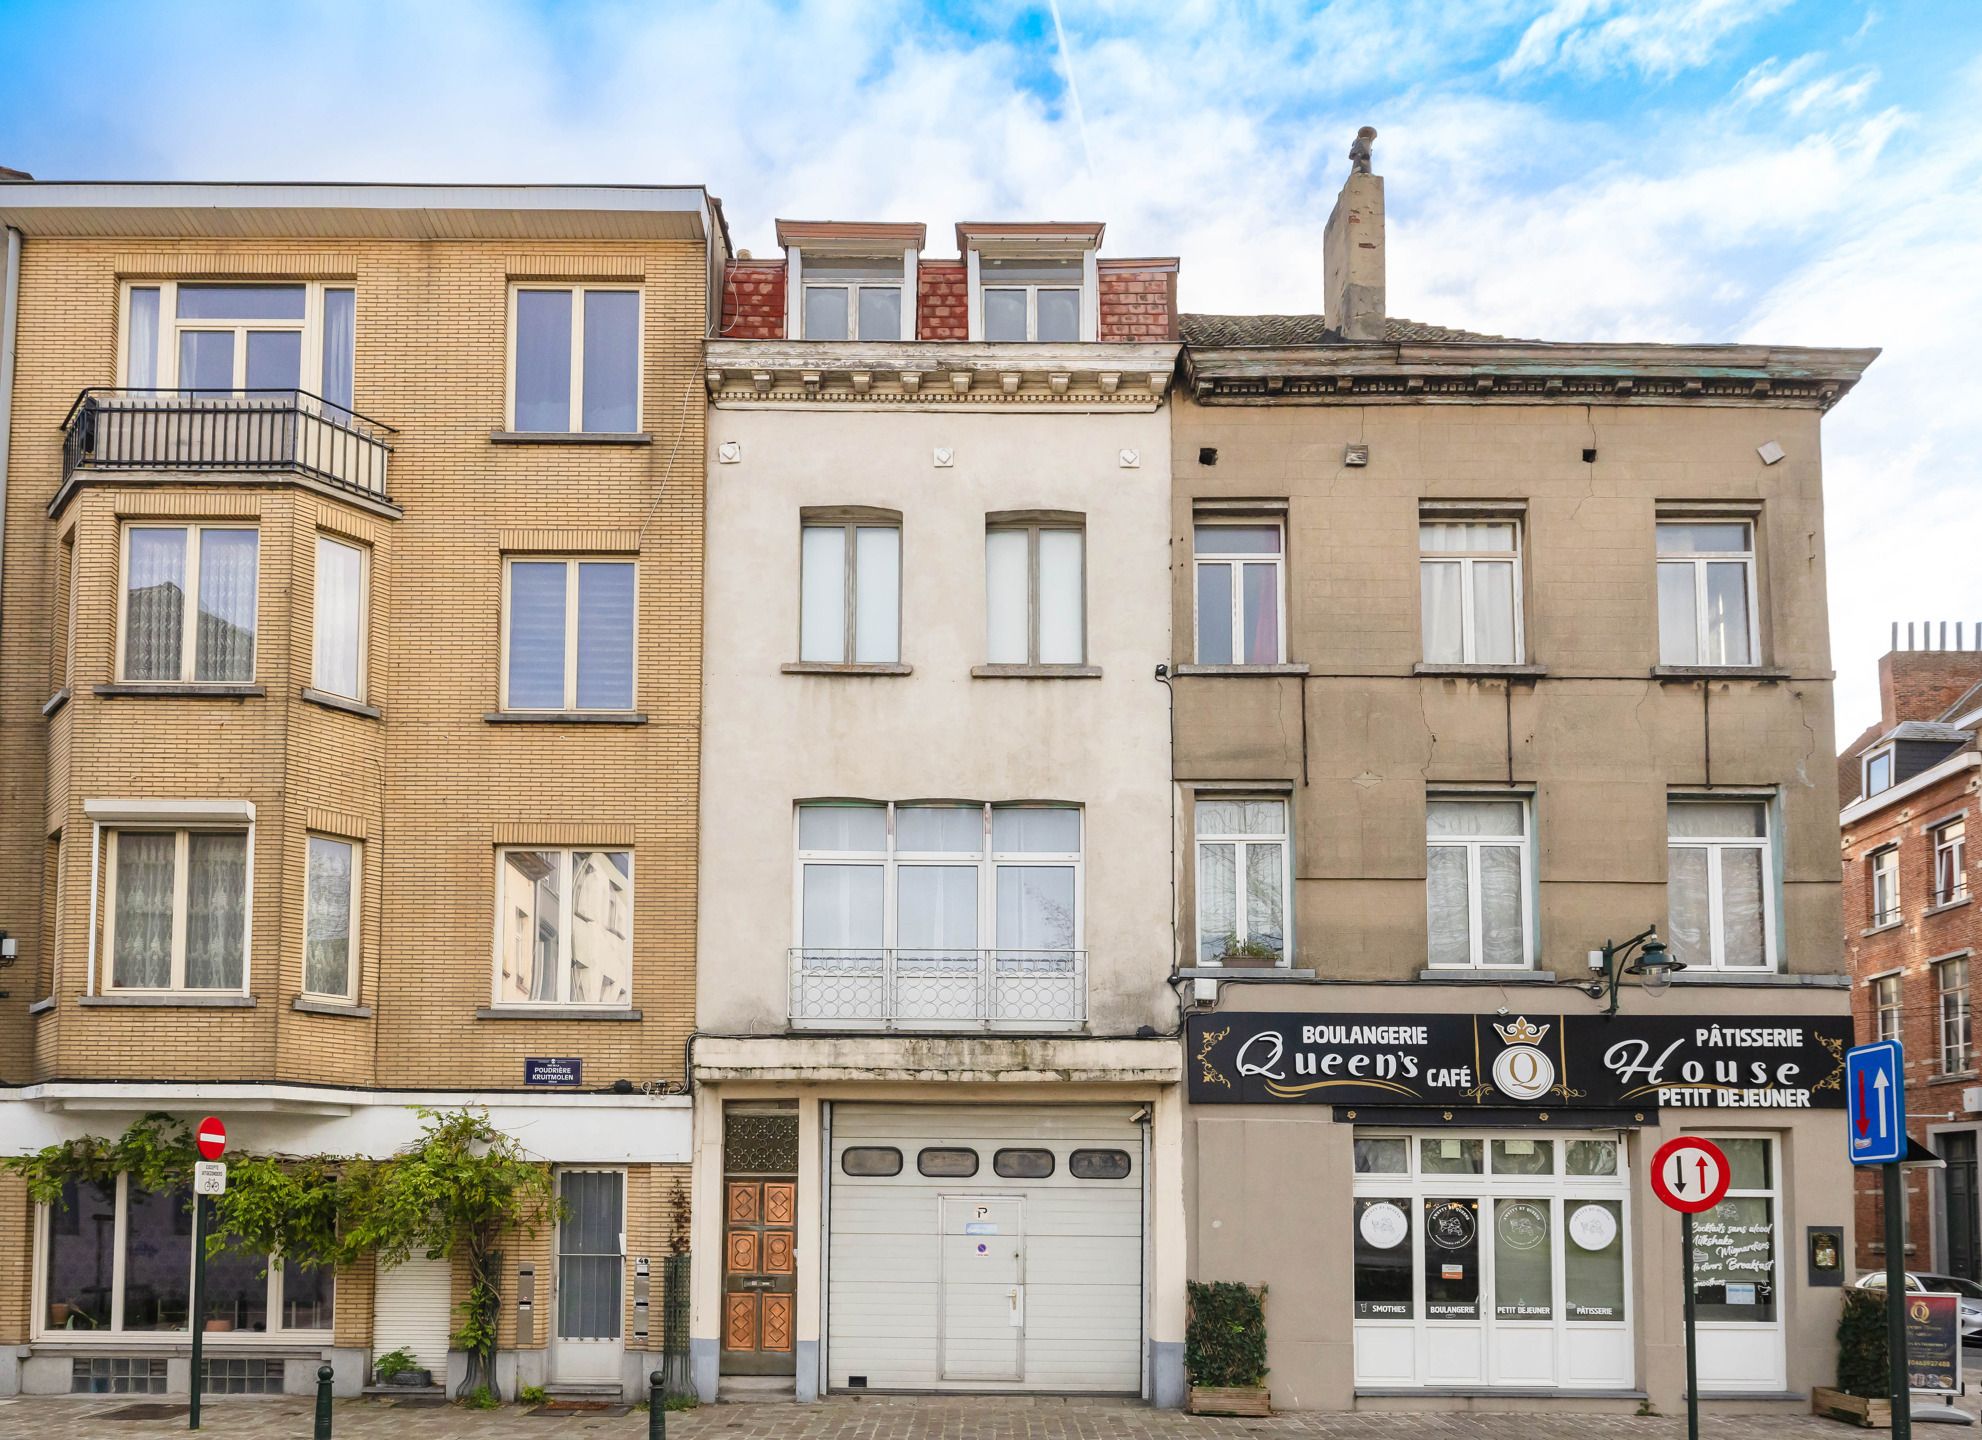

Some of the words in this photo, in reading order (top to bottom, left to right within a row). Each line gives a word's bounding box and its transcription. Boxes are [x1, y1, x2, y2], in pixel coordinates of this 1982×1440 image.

[1302, 1025, 1428, 1045] BOULANGERIE
[1696, 1024, 1803, 1048] PÂTISSERIE
[1236, 1030, 1419, 1080] Queen's
[1603, 1038, 1800, 1085] House
[1426, 1065, 1471, 1087] CAFÉ
[1509, 1052, 1542, 1091] Q
[1658, 1088, 1712, 1107] PETIT
[1717, 1088, 1811, 1108] DEJEUNER
[1726, 1257, 1775, 1272] Breakfast
[1372, 1304, 1406, 1313] SMOTHIES
[1430, 1306, 1475, 1314] BOULANGERIE
[1497, 1306, 1516, 1314] PETIT
[1576, 1305, 1613, 1315] PÂTISSERIE
